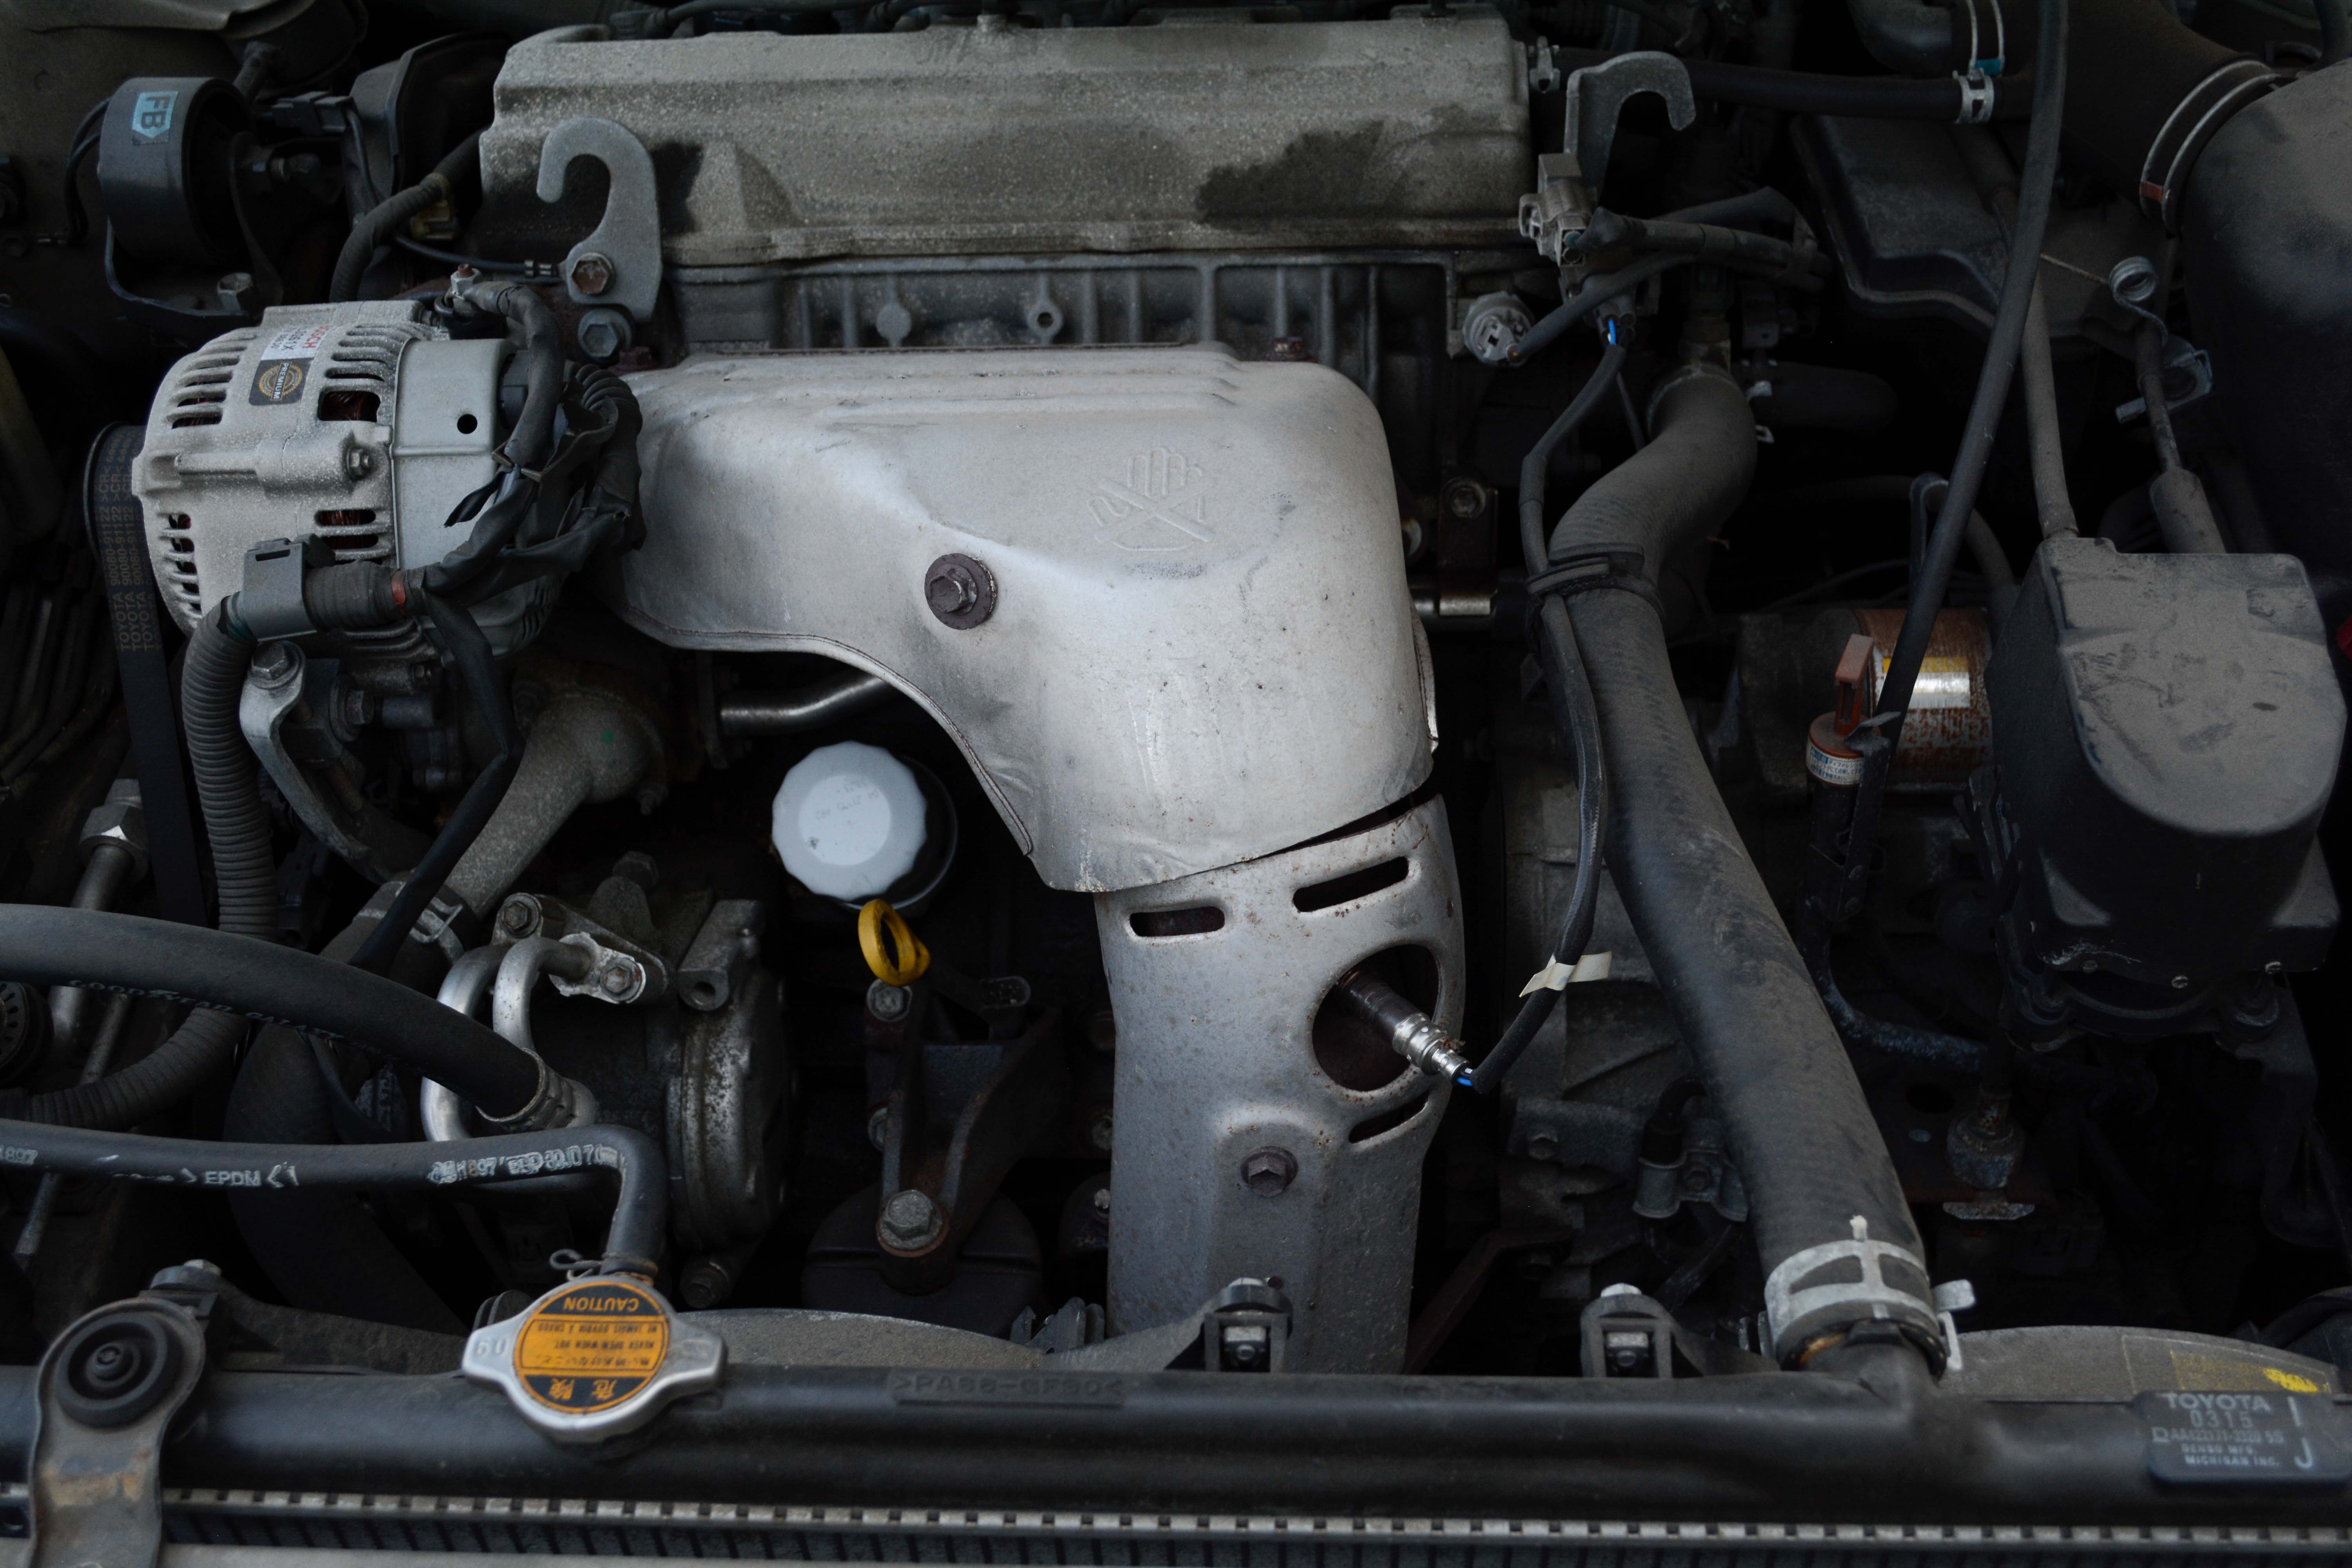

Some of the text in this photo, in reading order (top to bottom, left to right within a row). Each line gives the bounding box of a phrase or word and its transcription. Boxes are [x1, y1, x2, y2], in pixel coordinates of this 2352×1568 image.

[140, 96, 171, 129] FB
[273, 362, 290, 400] PREMIUM
[111, 506, 132, 586] 90080-91122
[112, 592, 131, 652] TOYOTA
[125, 592, 143, 652] TOYOTA
[136, 591, 155, 651] TOYOTA
[563, 1296, 640, 1312] CAUTION
[2160, 1393, 2272, 1412] TOYOTA
[2189, 1409, 2254, 1428] 0315
[2185, 1455, 2249, 1466] MICHIGAN
